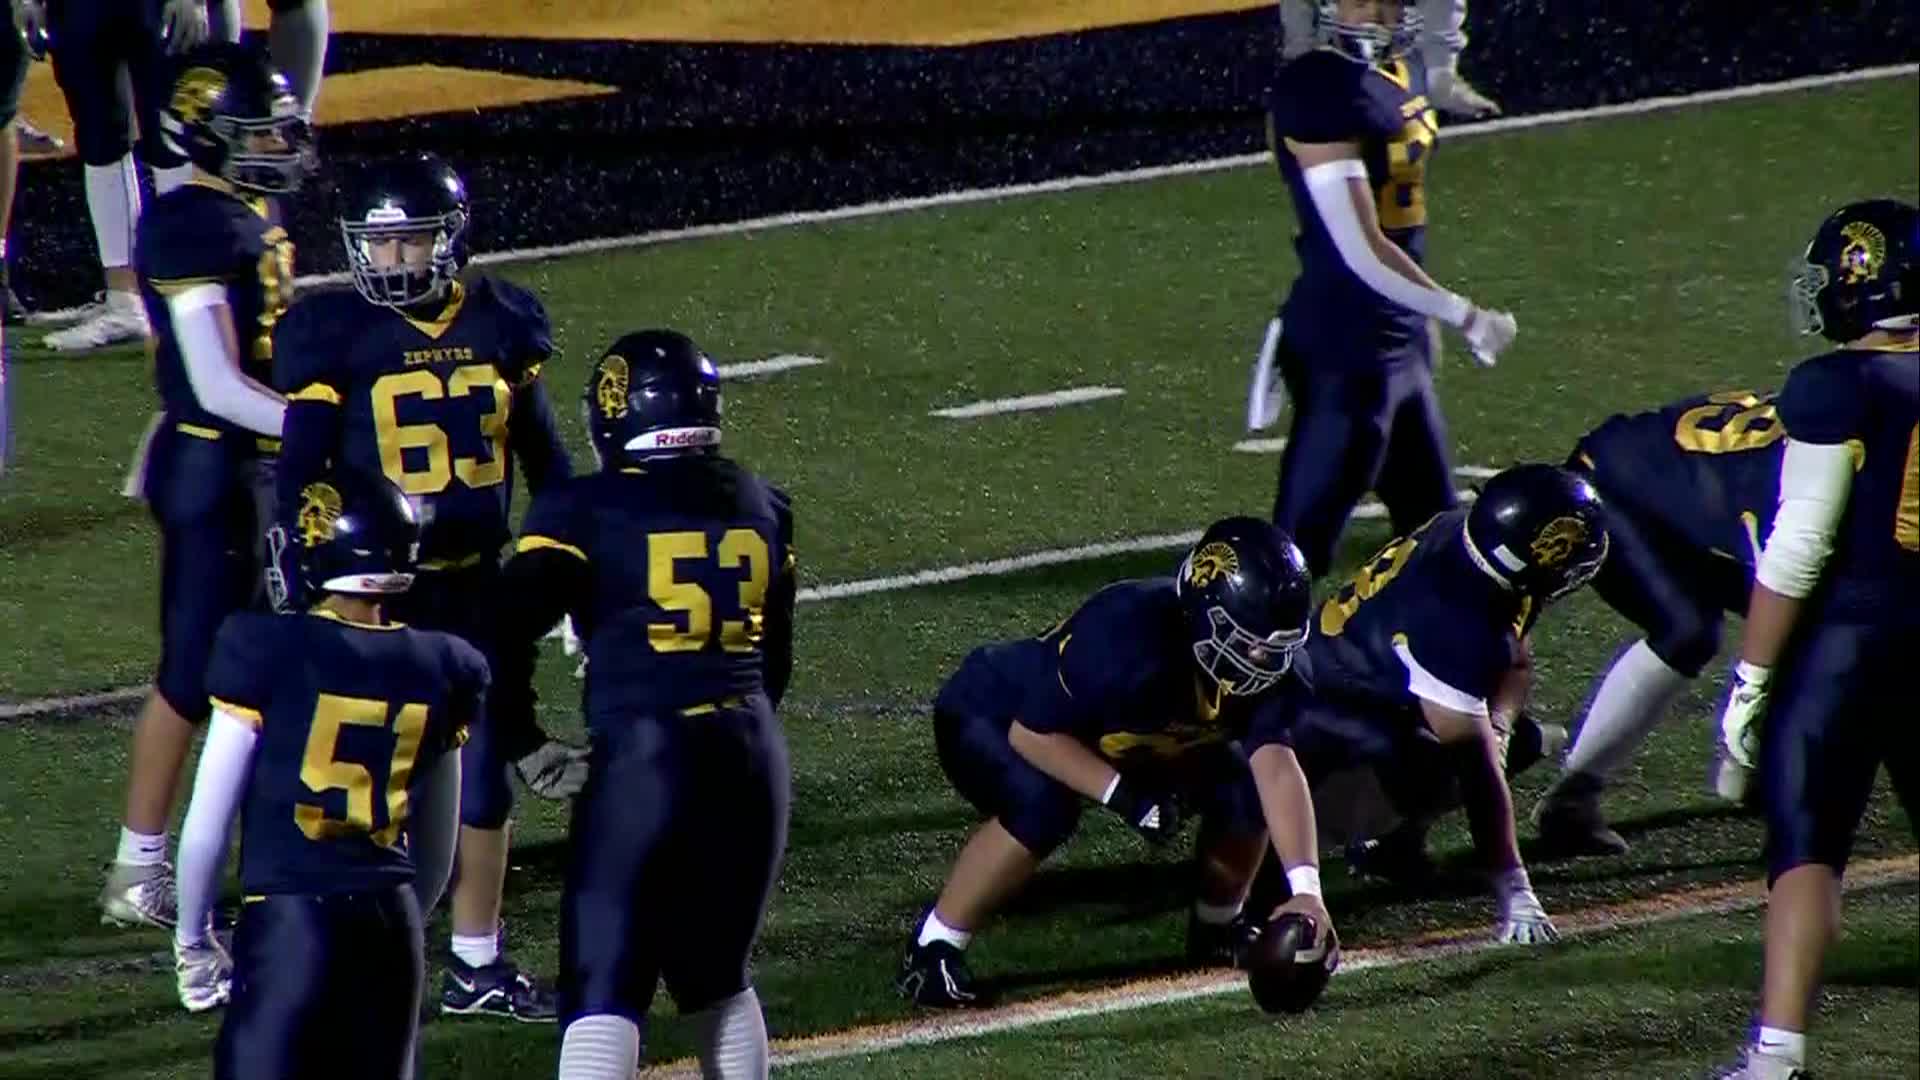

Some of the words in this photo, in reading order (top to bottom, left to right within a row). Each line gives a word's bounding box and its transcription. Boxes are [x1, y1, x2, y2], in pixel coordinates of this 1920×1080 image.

[371, 363, 511, 494] 63
[647, 528, 769, 653] 53
[294, 692, 429, 848] 51
